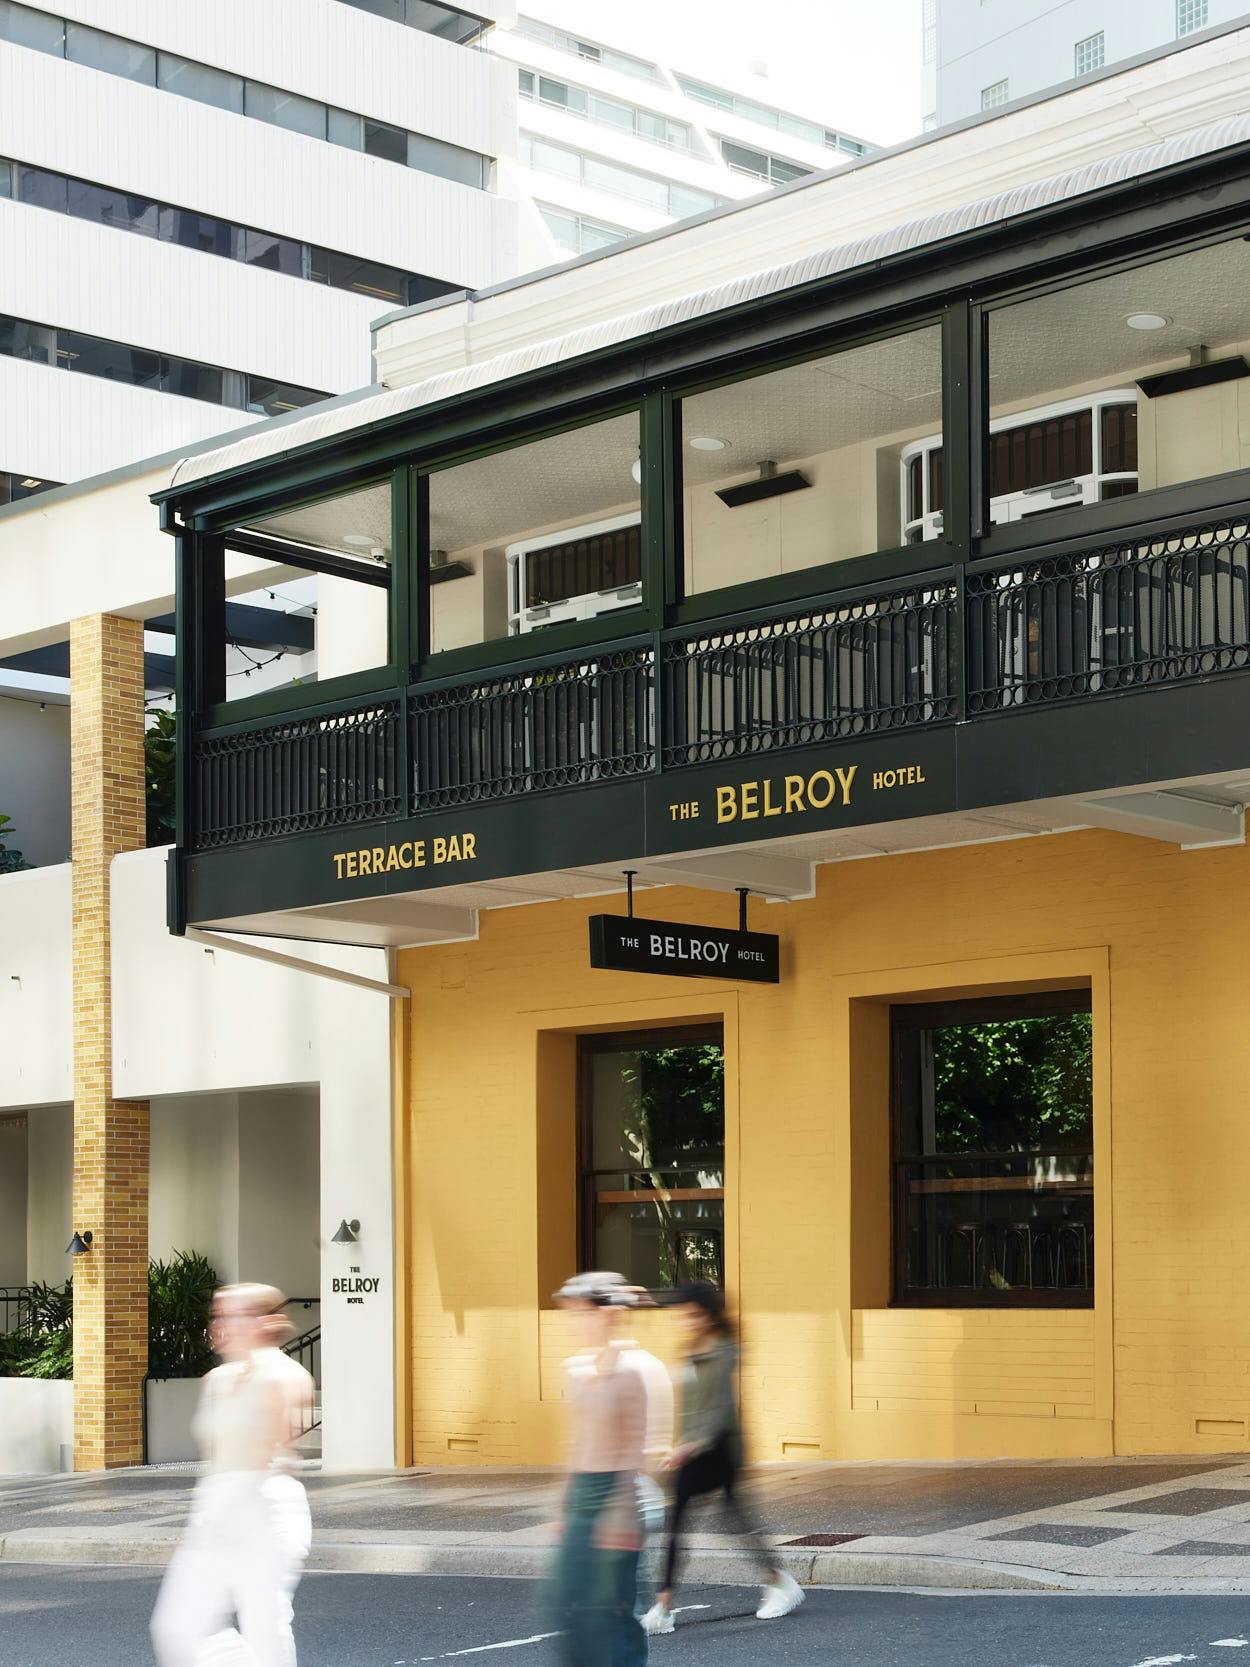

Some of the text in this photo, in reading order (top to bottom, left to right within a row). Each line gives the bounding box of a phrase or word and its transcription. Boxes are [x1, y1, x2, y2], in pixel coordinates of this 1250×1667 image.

[669, 765, 925, 824] THE BELROY HOTEL
[333, 832, 477, 879] TERRACE BAR
[620, 934, 765, 963] THE BELROY HOTEL
[332, 1278, 379, 1292] BELROY
